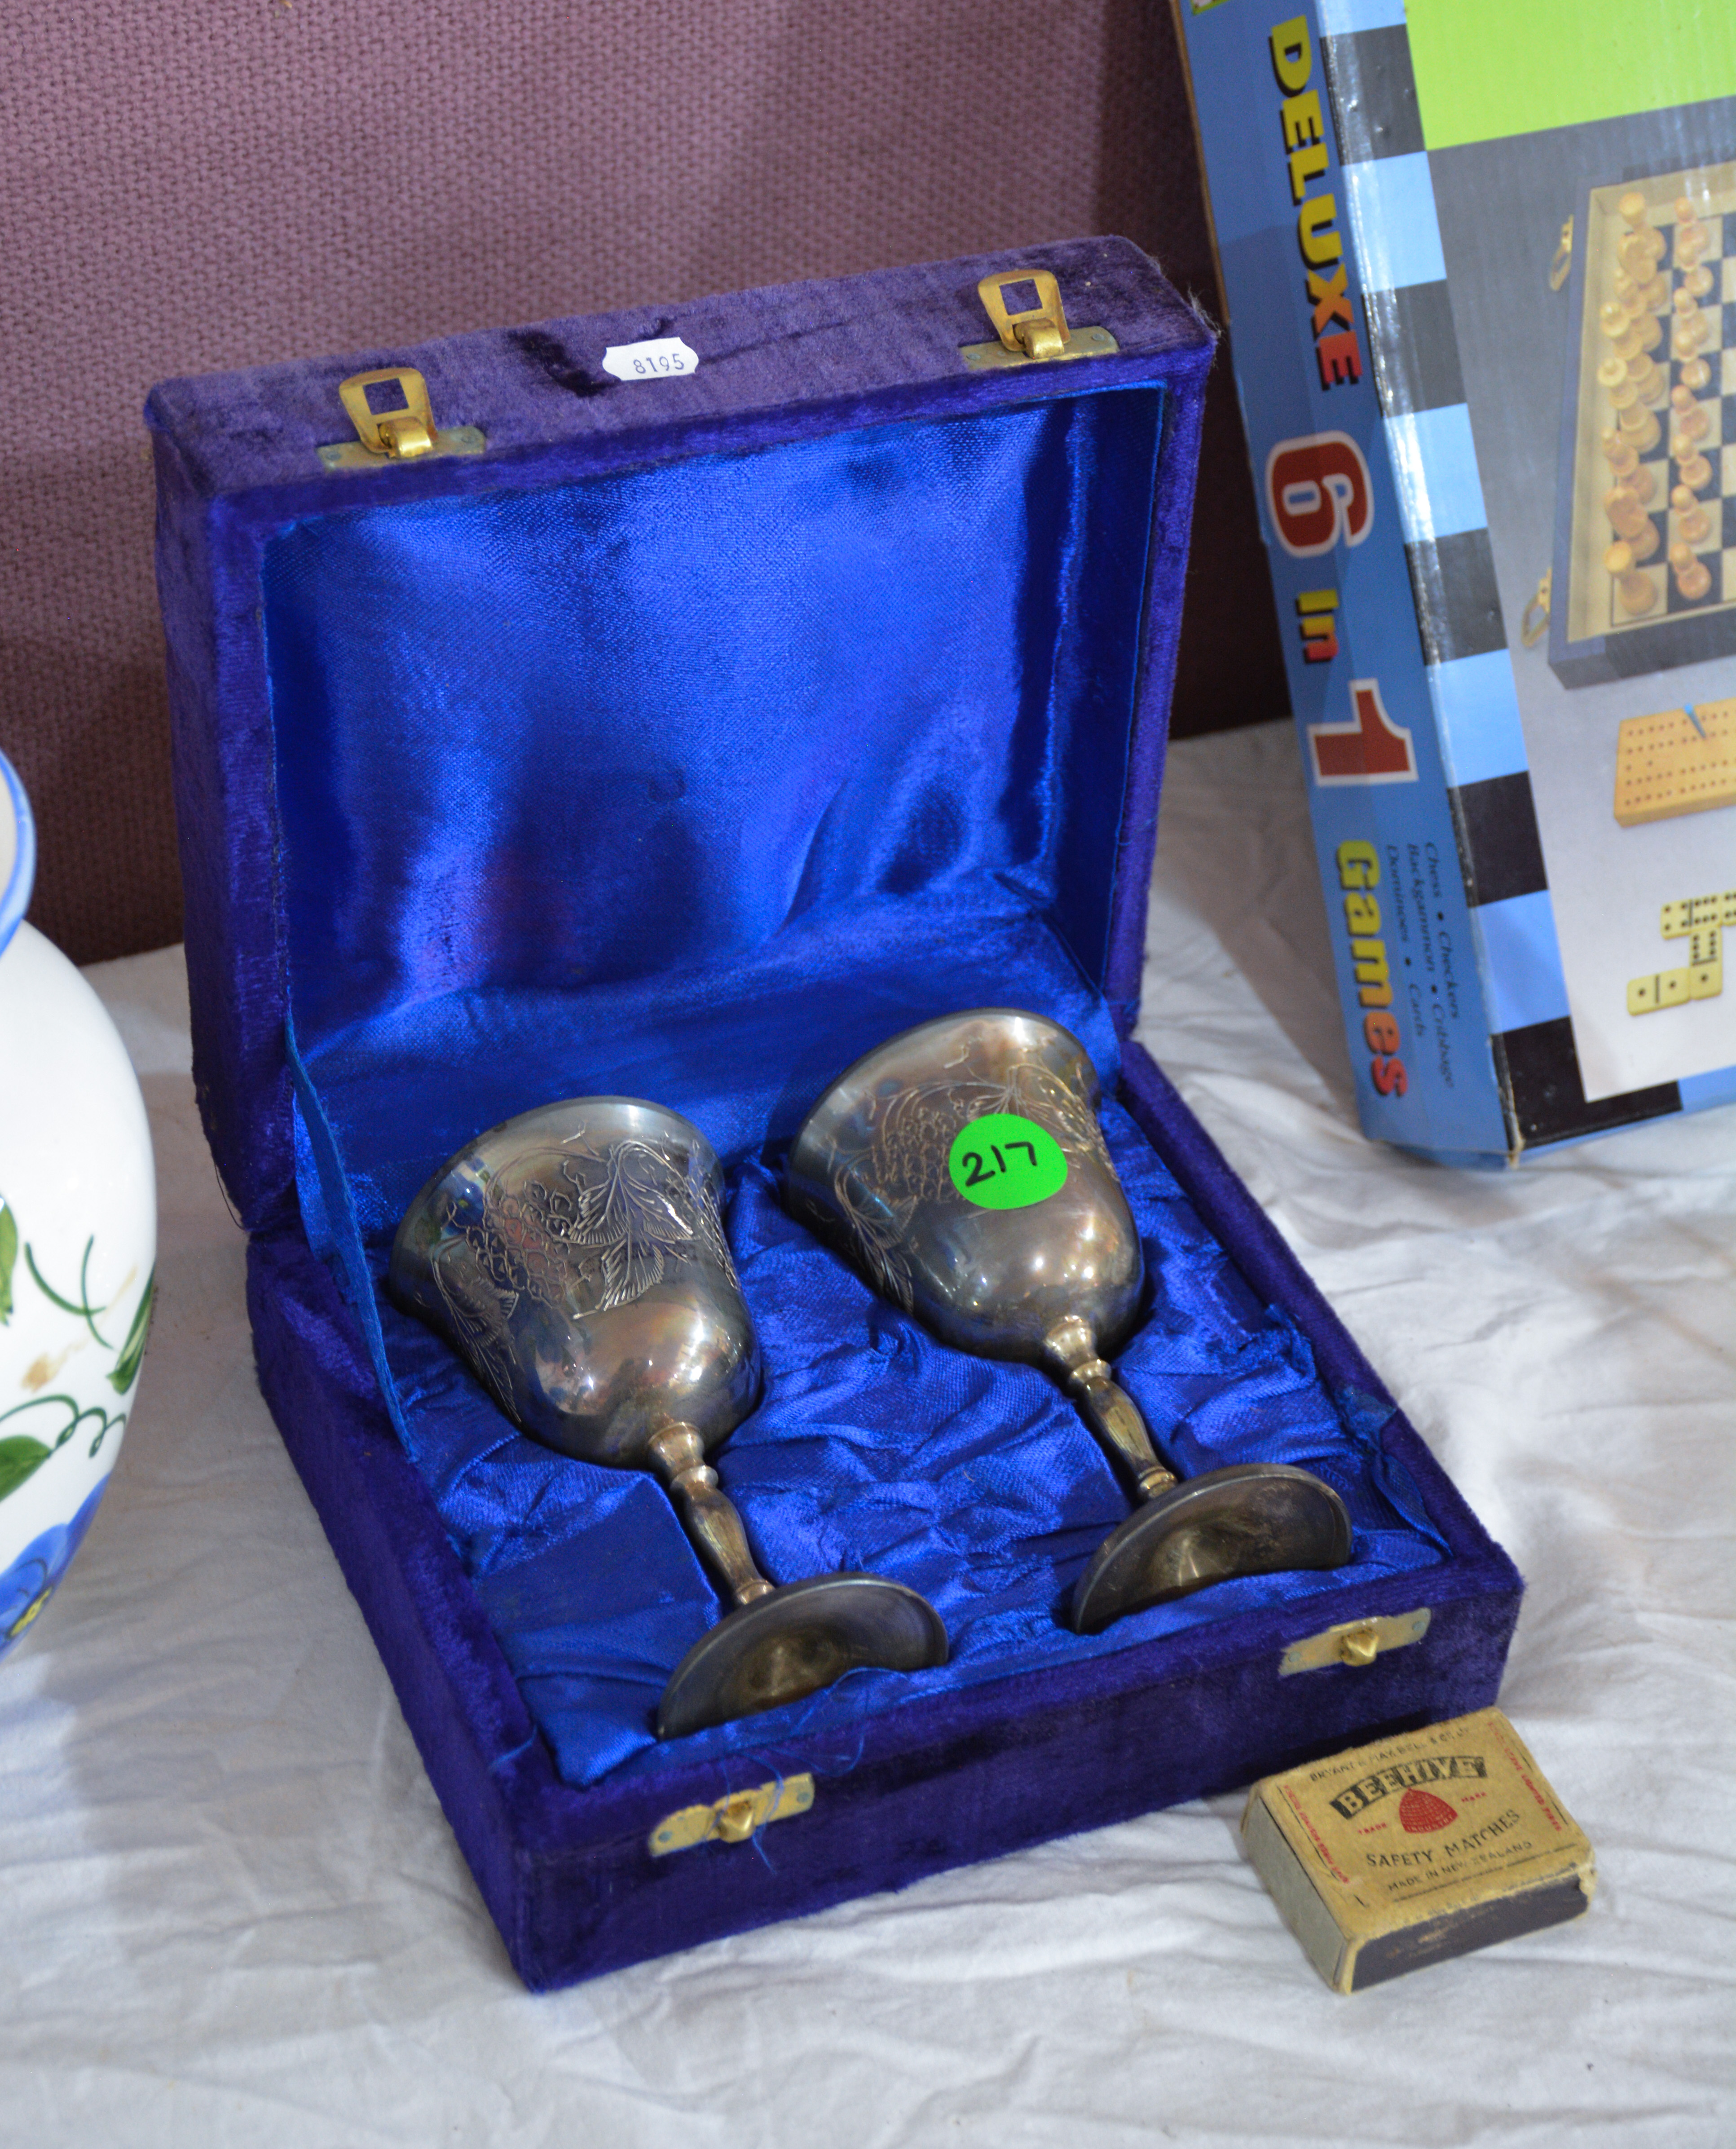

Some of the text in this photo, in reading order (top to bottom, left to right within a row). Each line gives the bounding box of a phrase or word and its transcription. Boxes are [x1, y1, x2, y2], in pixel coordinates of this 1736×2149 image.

[633, 353, 684, 374] 8195
[1265, 15, 1419, 1097] DELUXE 6 in 1 Games
[1386, 845, 1426, 1037] Dominoes Cards
[1425, 841, 1458, 1019] Chess Checkers
[1407, 843, 1454, 1088] Backgammon Cribbage
[962, 1141, 1037, 1187] 217
[1334, 1757, 1483, 1818] BEEHIVE
[1357, 1791, 1487, 1835] TRADE MARK
[1366, 1809, 1520, 1867] SAFETY MATCHES
[1388, 1840, 1533, 1891] MADE IN NEW ZEALAND
